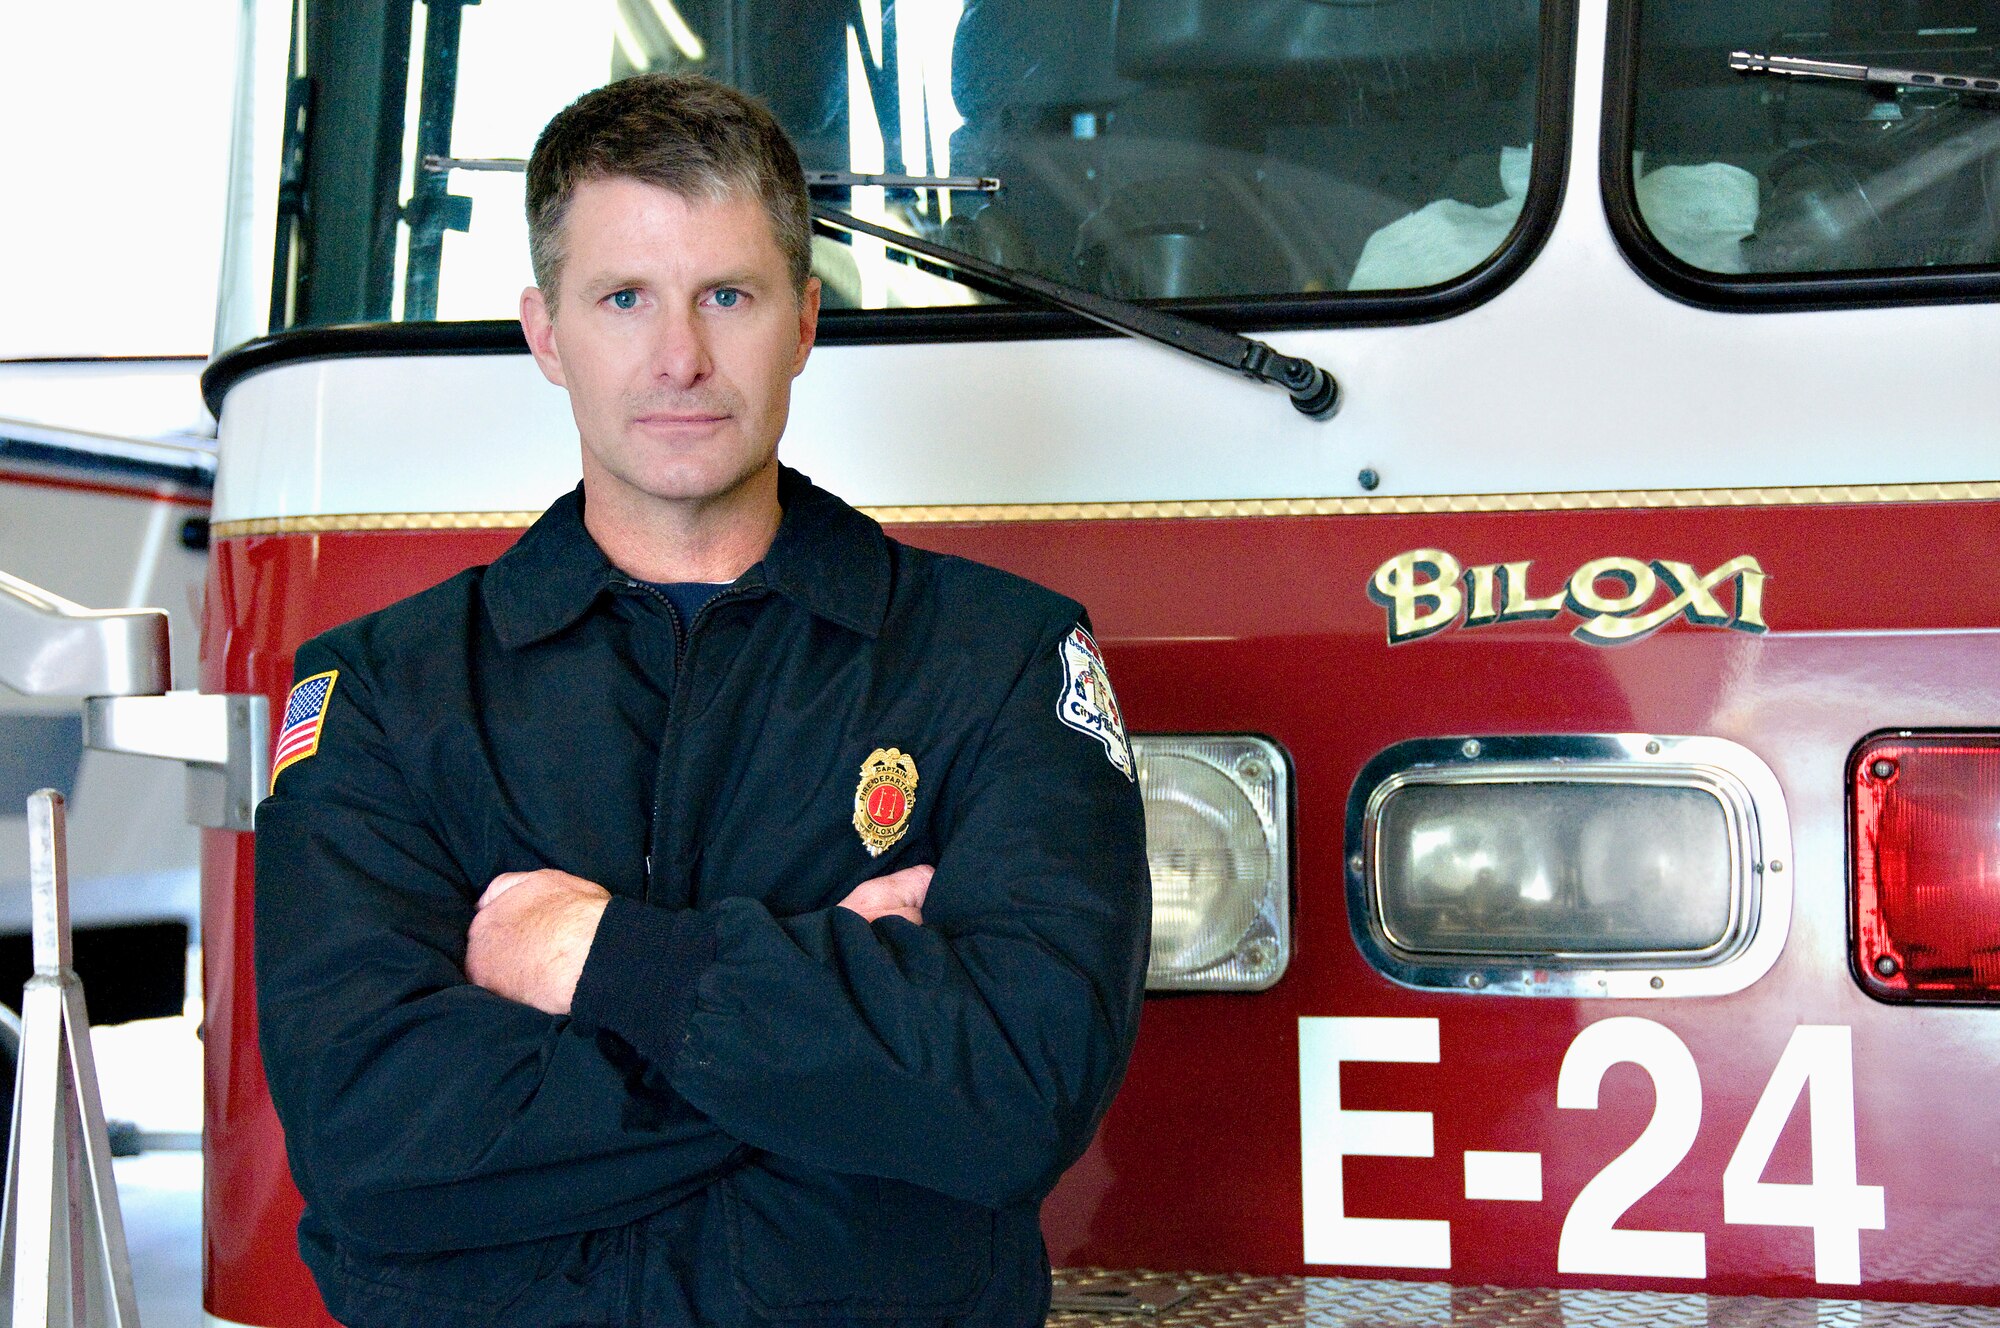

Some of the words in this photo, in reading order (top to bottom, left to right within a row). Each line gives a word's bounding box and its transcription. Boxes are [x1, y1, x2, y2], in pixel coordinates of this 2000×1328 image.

[1367, 548, 1772, 646] BILOXI
[876, 766, 908, 779] CAPTAIN
[859, 781, 874, 801] FIRE
[874, 775, 914, 810] DEPARTMENT
[867, 822, 896, 835] BILOXI
[1297, 1016, 1886, 1286] E-24
